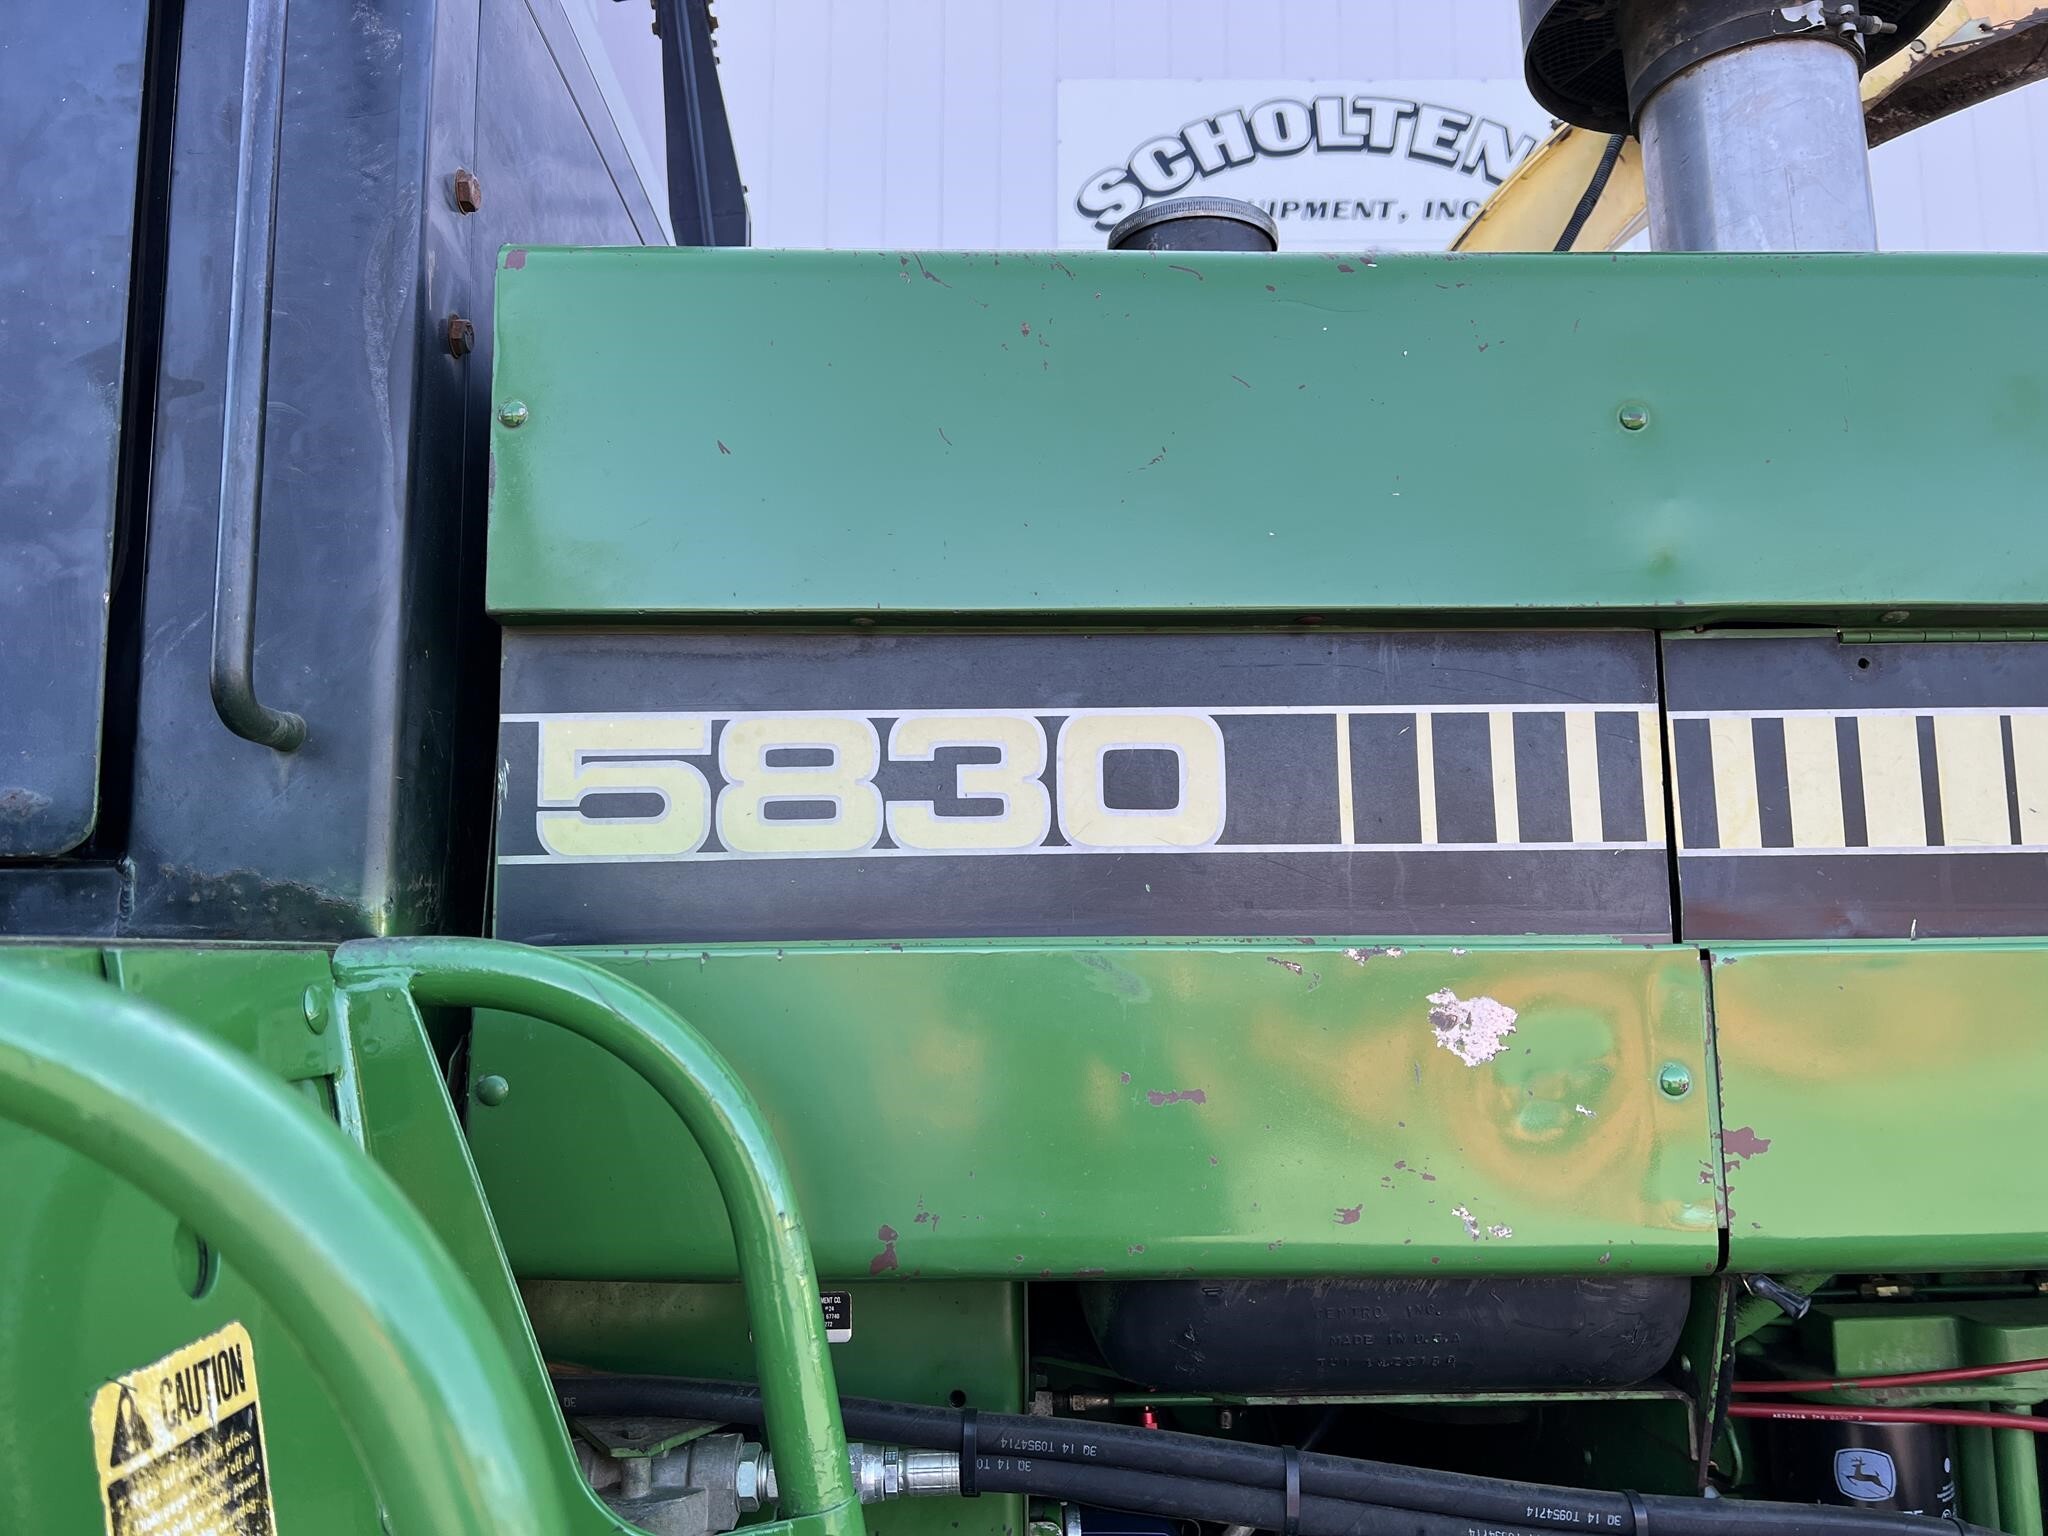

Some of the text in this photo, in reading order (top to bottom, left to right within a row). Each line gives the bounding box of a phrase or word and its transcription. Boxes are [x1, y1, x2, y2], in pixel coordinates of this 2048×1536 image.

[1076, 95, 1537, 231] SCHOLTEN
[536, 714, 1227, 857] 5830
[158, 1343, 247, 1432] CAUTION
[997, 1459, 1010, 1471] 14
[1062, 1443, 1075, 1455] 14
[1587, 1512, 1600, 1525] 14
